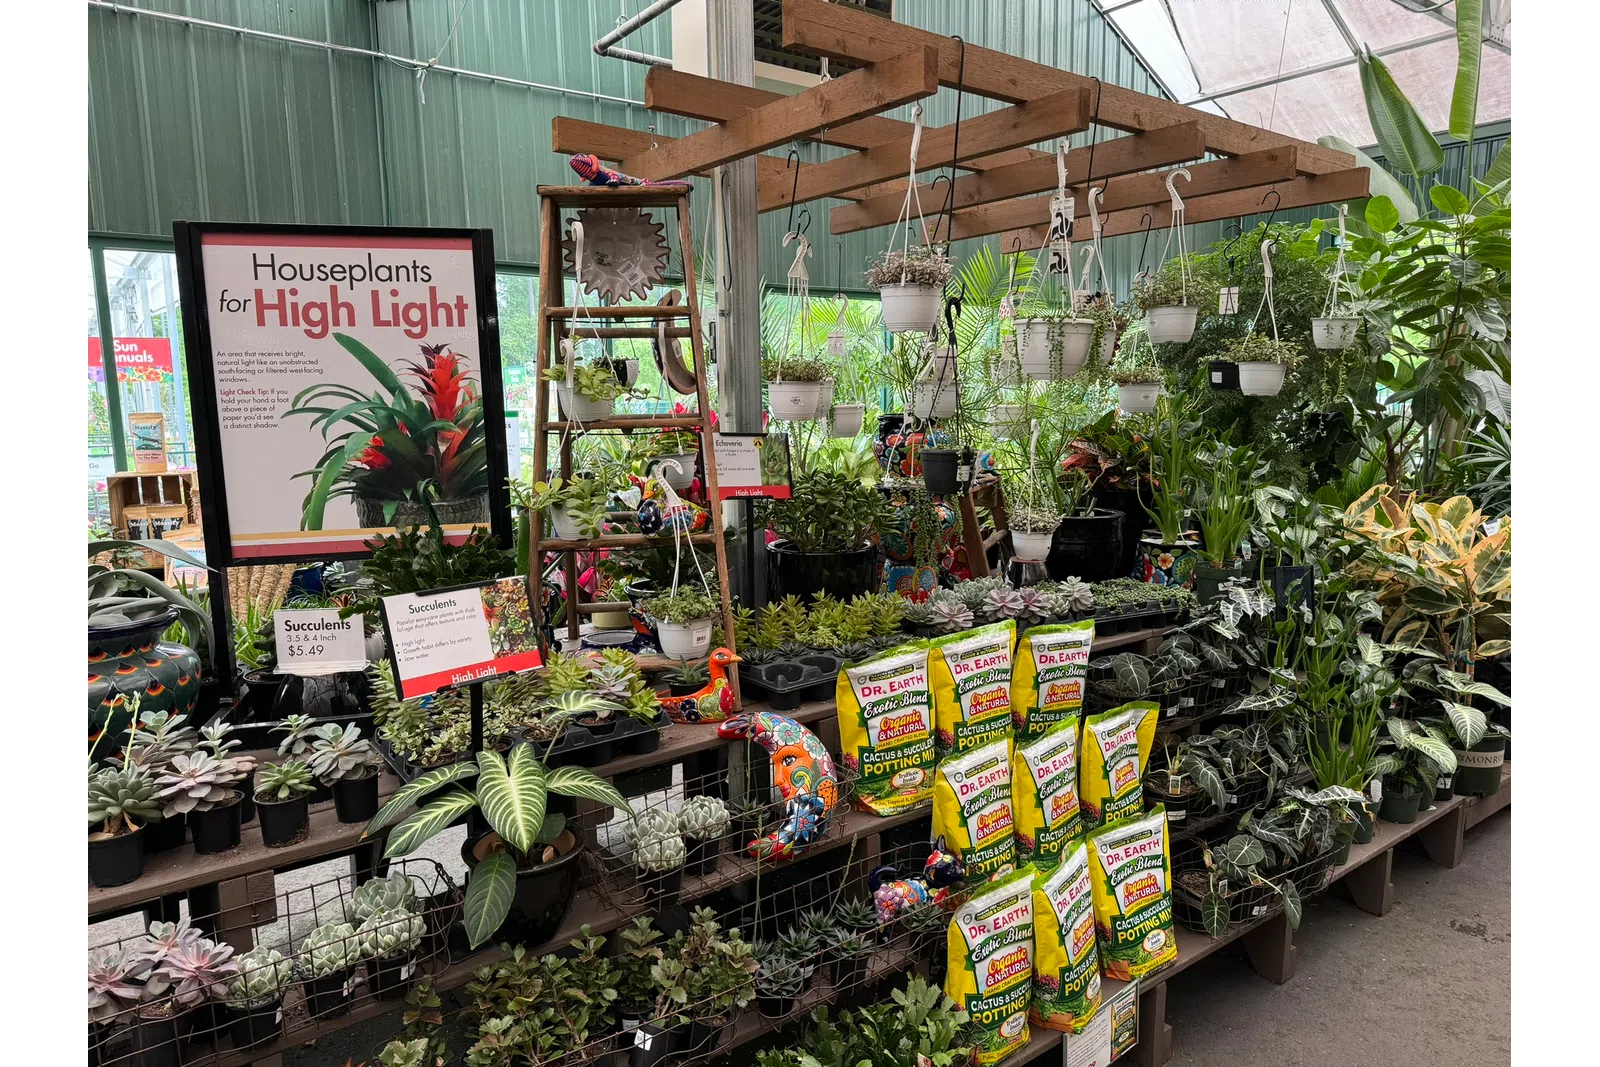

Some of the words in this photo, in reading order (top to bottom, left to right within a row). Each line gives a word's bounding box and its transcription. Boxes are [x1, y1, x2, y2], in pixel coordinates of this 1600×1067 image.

[252, 253, 432, 290] Houseplants
[219, 290, 251, 312] for
[254, 285, 356, 339] High
[371, 286, 468, 339] Light
[114, 340, 138, 352] Sun
[241, 359, 255, 367] light
[409, 599, 457, 614] Succulents
[285, 618, 351, 631] Succulents
[287, 634, 300, 642] 3.5
[320, 633, 336, 641] Inch
[288, 644, 324, 657] $5.49
[1059, 651, 1088, 662] EARTH
[975, 654, 1008, 670] EARTH
[452, 671, 474, 684] High
[476, 665, 497, 679] Light
[889, 675, 924, 692] EARTH
[958, 676, 984, 693] Exotic
[985, 669, 1011, 682] Blend
[1039, 668, 1064, 682] Exotic
[972, 686, 1006, 705] Organic
[1048, 680, 1081, 695] Organic
[1051, 692, 1081, 702] NATURAL
[864, 698, 898, 718] Exotic
[900, 690, 928, 707] Blend
[976, 699, 1009, 712] NATURAL
[881, 709, 921, 732] Organic
[1030, 713, 1055, 722] CACTUS
[887, 723, 924, 739] NATURAL
[893, 735, 913, 745] CRAFTED
[958, 725, 984, 736] CACTUS
[959, 728, 1004, 750] POTTING
[863, 752, 896, 762] CACTUS
[864, 754, 921, 777] POTTING
[978, 767, 1008, 788] EARTH
[964, 792, 987, 818] Exotic
[1106, 801, 1139, 824] POTTING
[977, 804, 1008, 827] Organic
[984, 815, 1012, 836] NATURAL
[1040, 830, 1063, 842] CACTUS
[1040, 824, 1075, 854] POTTING
[966, 849, 994, 863] CACTUS
[1124, 839, 1160, 858] EARTH
[1110, 867, 1135, 886] Exotic
[1135, 855, 1163, 872] Blend
[1069, 874, 1090, 898] EARTH
[1123, 873, 1156, 896] Organic
[1129, 886, 1160, 903] NATURAL
[993, 905, 1029, 930] EARTH
[1116, 916, 1139, 931] CACTUS
[1144, 896, 1170, 918] SUCCULENT
[1118, 917, 1160, 944] POTTING
[972, 936, 1002, 962] Exotic
[1003, 924, 1033, 944] Blend
[988, 946, 1027, 974] Organic
[995, 963, 1030, 983] NATURAL
[1064, 960, 1086, 982] CACTUS
[1065, 962, 1098, 997] POTTING
[986, 985, 1000, 995] HAND
[1001, 976, 1020, 989] CRAFTED
[971, 998, 1005, 1012] CACTUS
[972, 997, 1025, 1024] POTTING
